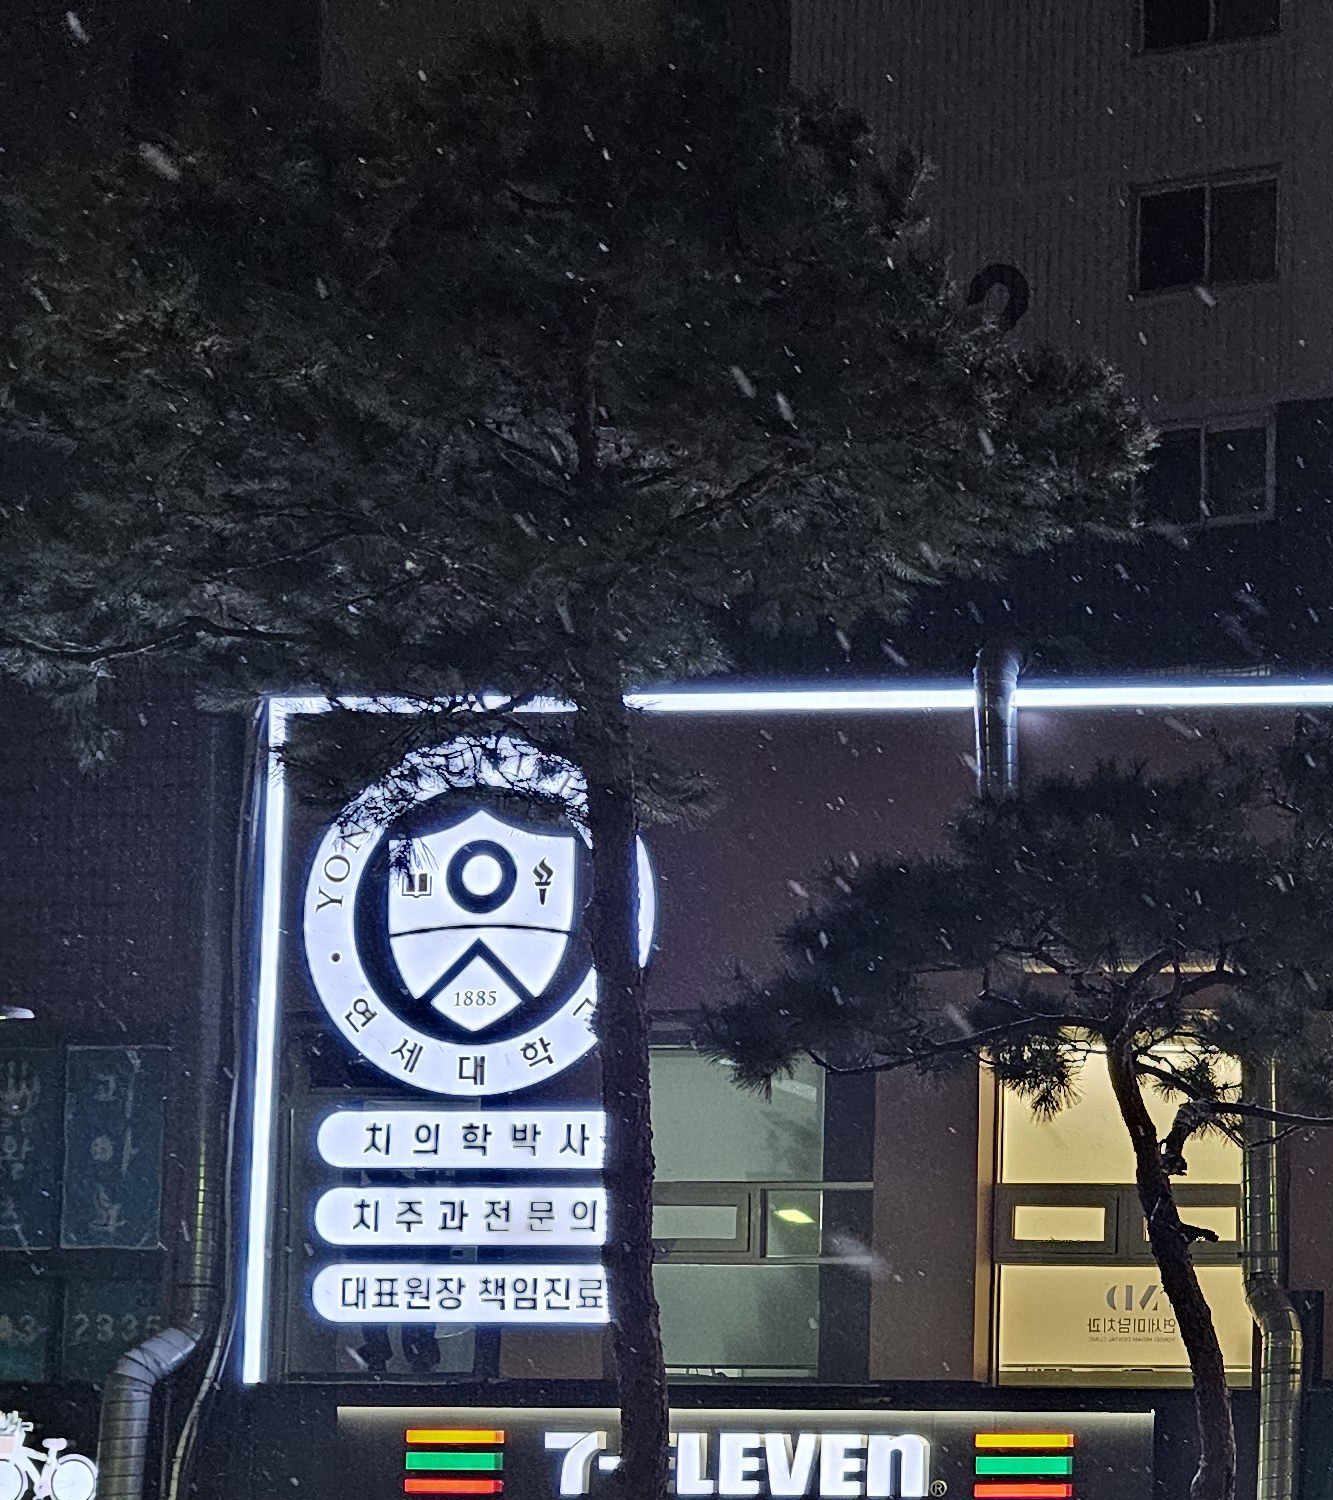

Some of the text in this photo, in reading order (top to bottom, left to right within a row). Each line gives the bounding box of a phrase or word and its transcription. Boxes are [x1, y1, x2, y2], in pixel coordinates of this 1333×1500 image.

[453, 990, 498, 1007] 1885
[363, 1121, 591, 1158] 치의학박사
[351, 1199, 599, 1235] 치주과전문의
[340, 1276, 605, 1312] 대표원장 책임진료
[543, 1430, 930, 1499] 7-LEVEn
